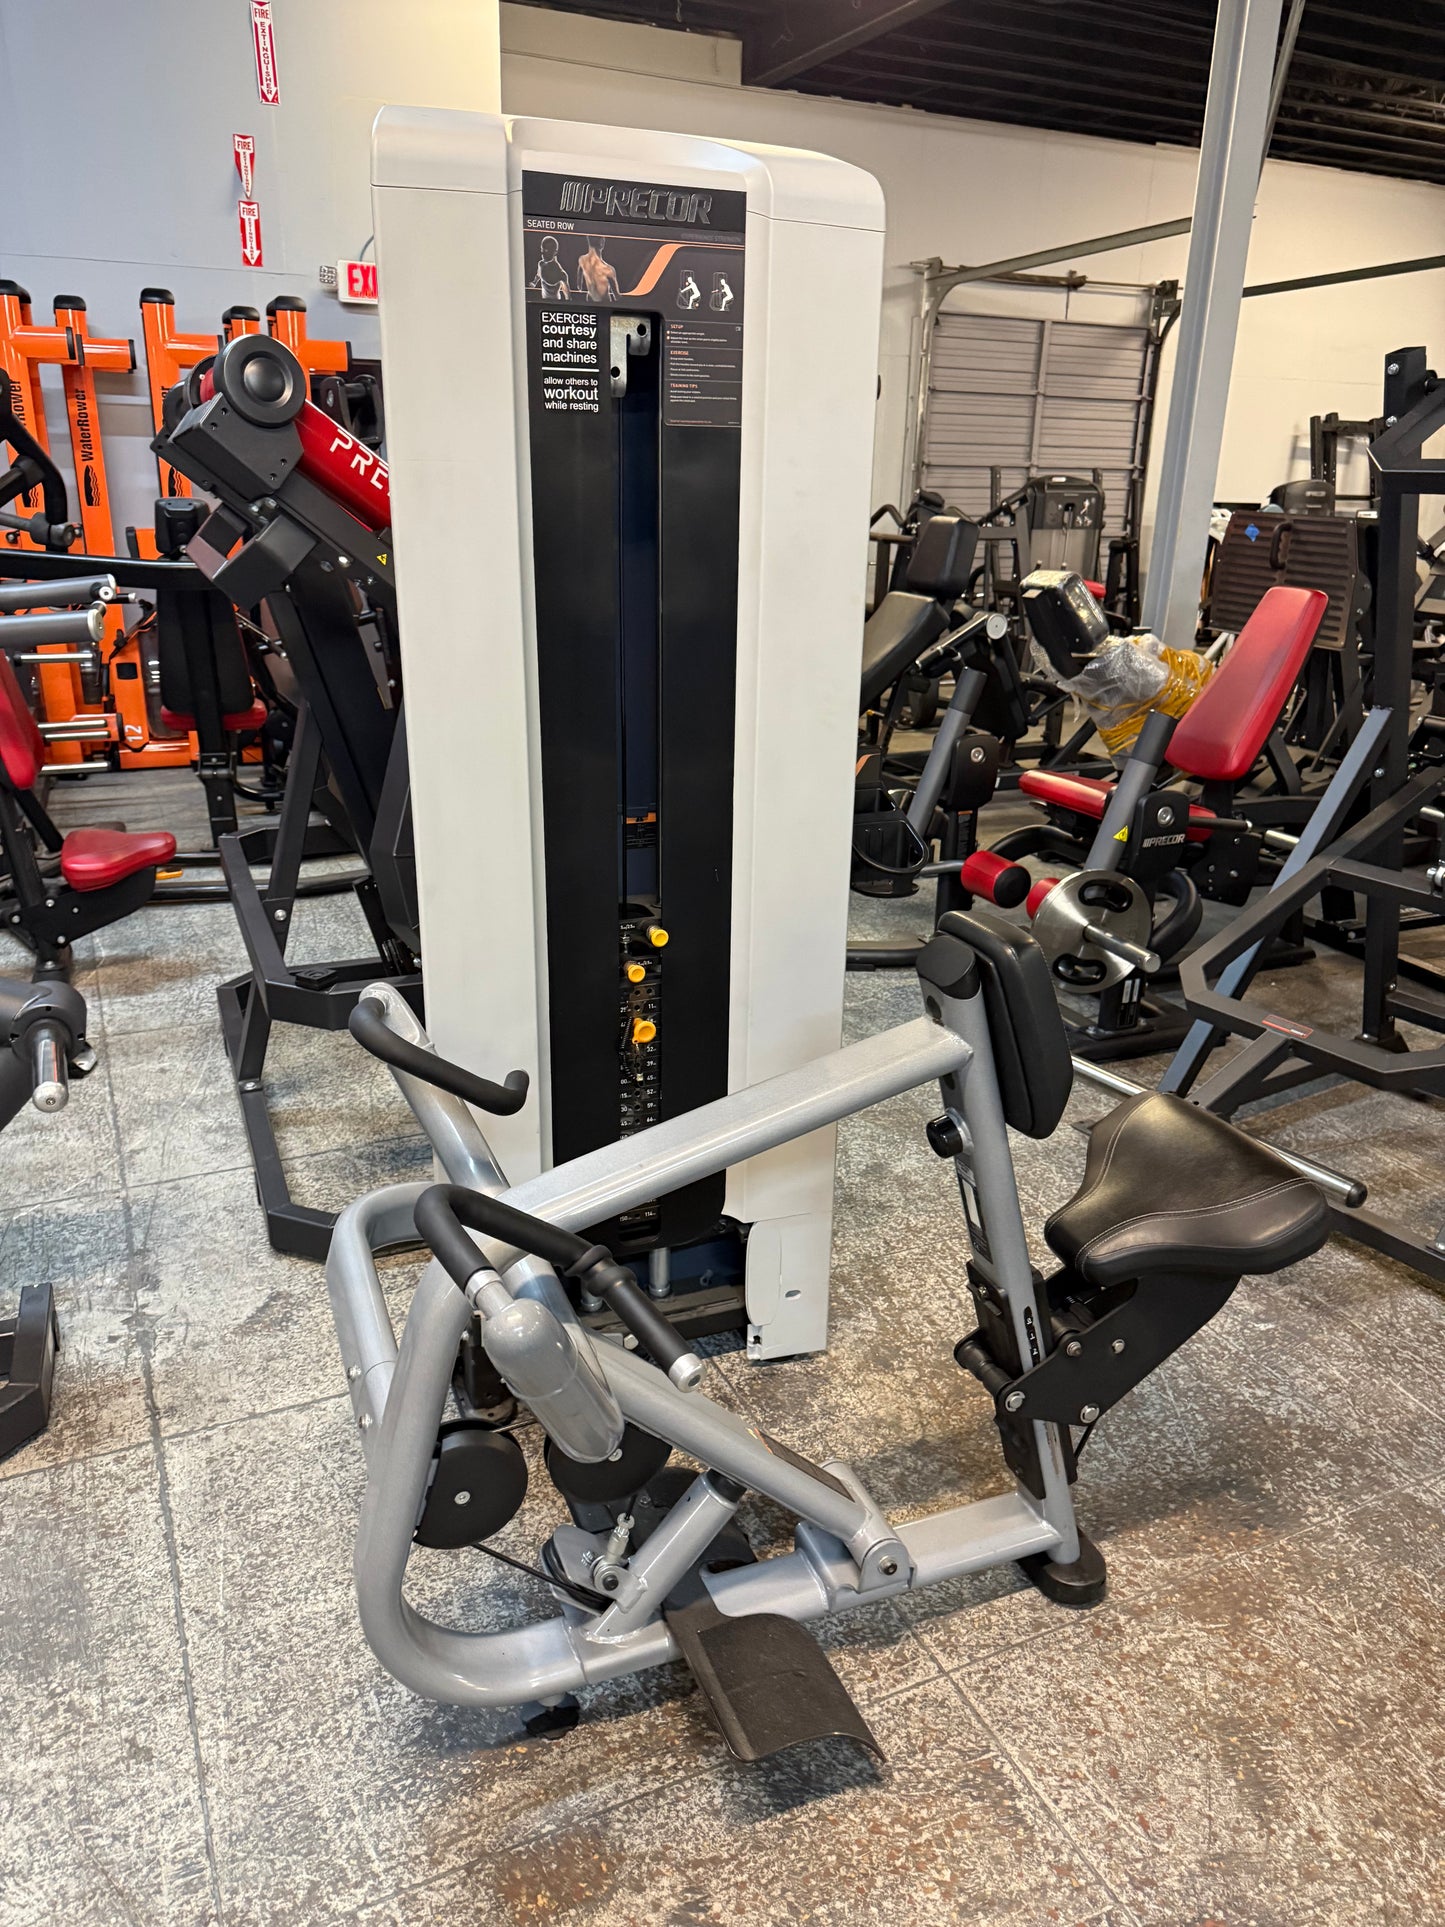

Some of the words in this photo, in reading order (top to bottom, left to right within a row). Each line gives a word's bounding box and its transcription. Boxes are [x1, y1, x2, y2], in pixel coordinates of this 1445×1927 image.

[254, 8, 270, 19] FIRE
[260, 22, 273, 95] EXTINGUISHER
[237, 141, 252, 151] FIRE
[582, 182, 713, 225] PRECOR
[242, 207, 256, 217] FIRE
[527, 219, 556, 229] SEATED
[557, 221, 575, 231] ROW
[347, 262, 378, 299] EXI
[541, 312, 597, 325] EXERCISE
[542, 324, 597, 338] courtesy
[542, 337, 563, 348] and
[566, 338, 597, 350] share
[542, 351, 597, 364] machines
[543, 376, 564, 385] allow
[565, 377, 590, 386] others
[590, 378, 598, 386] to
[543, 386, 599, 400] workout
[545, 401, 567, 410] while
[569, 401, 599, 412] resting
[75, 388, 94, 462] WaterRower
[329, 428, 391, 498] PRE
[125, 724, 143, 742] 12
[1149, 833, 1186, 847] PRECOR
